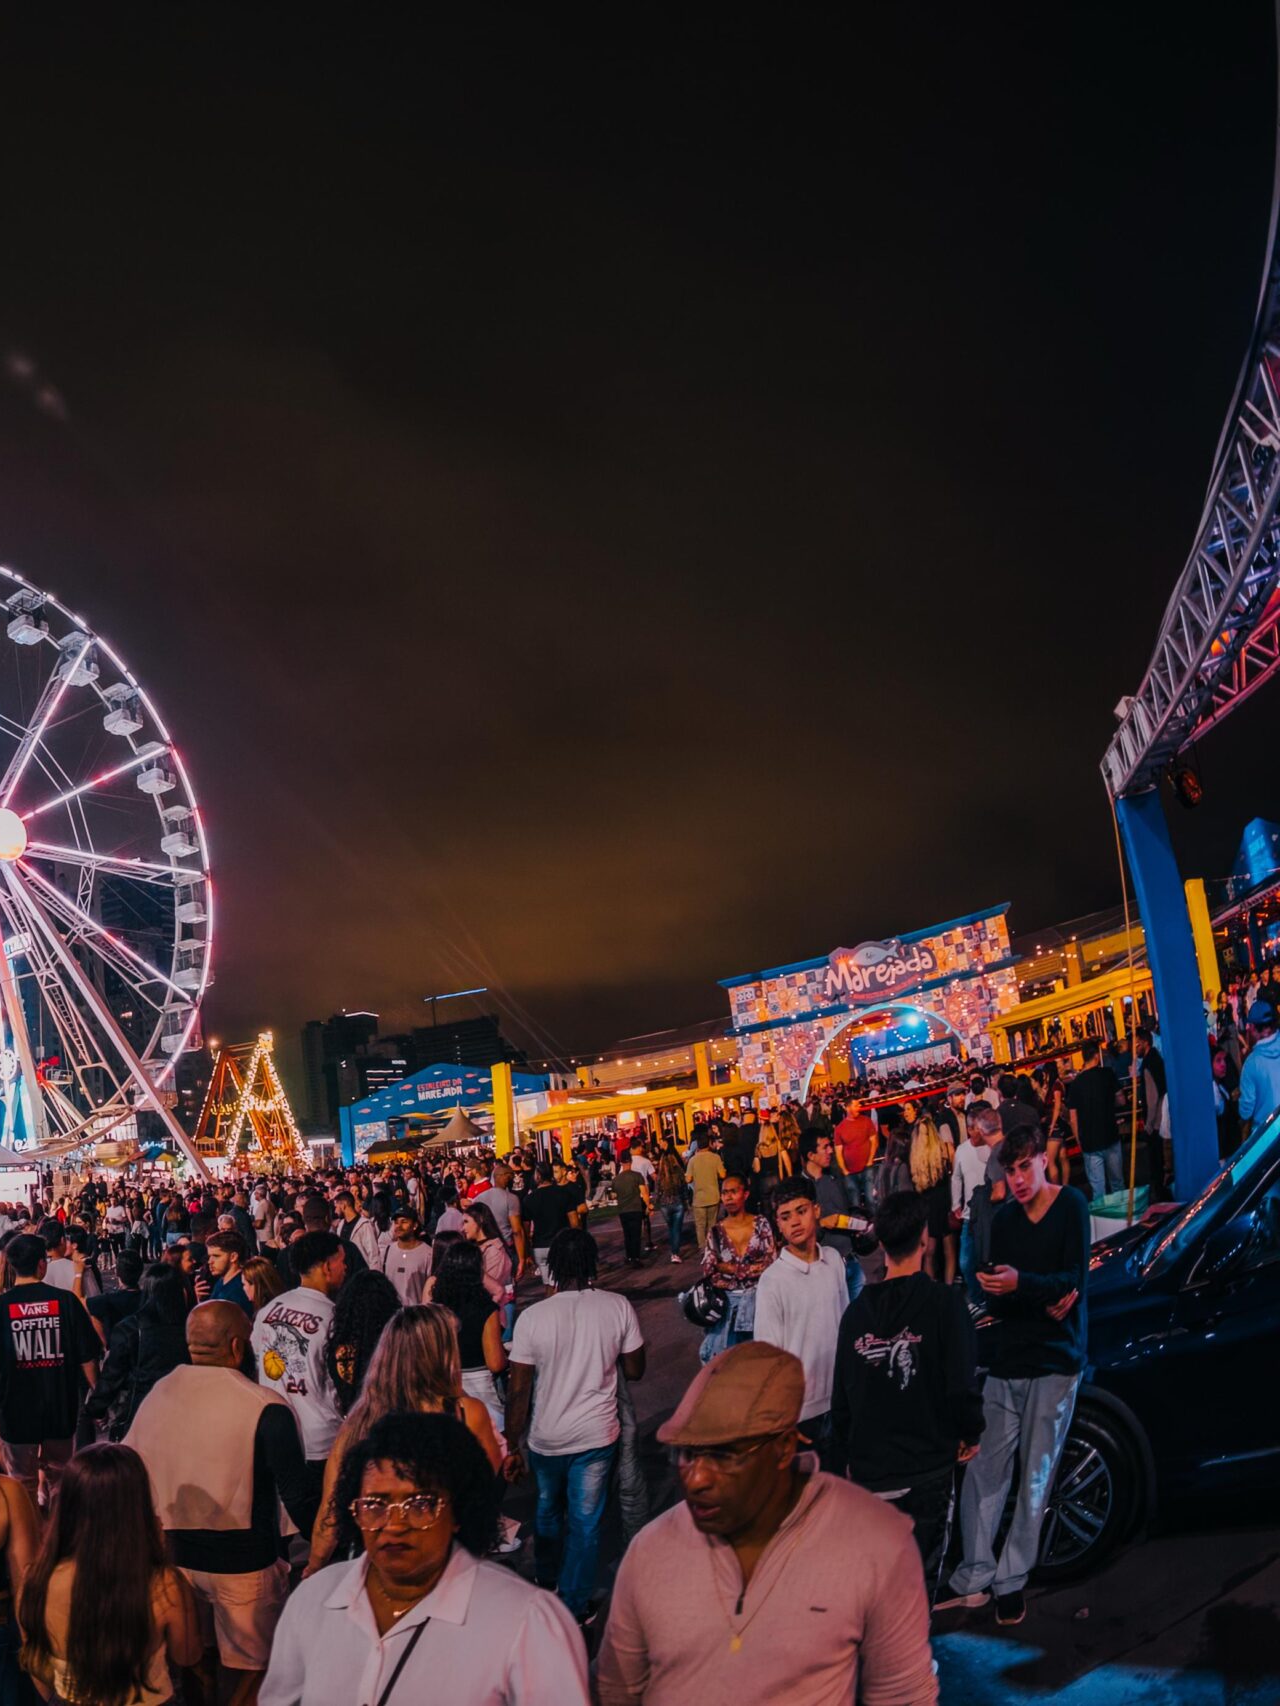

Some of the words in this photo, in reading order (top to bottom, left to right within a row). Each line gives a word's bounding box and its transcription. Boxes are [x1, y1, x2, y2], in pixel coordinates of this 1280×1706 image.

[827, 947, 933, 997] Marejada
[417, 1085, 463, 1102] MAREJADA
[18, 1302, 50, 1316] VANS
[263, 1302, 324, 1335] LAKERS
[12, 1328, 64, 1361] WALL
[287, 1375, 308, 1397] 24
